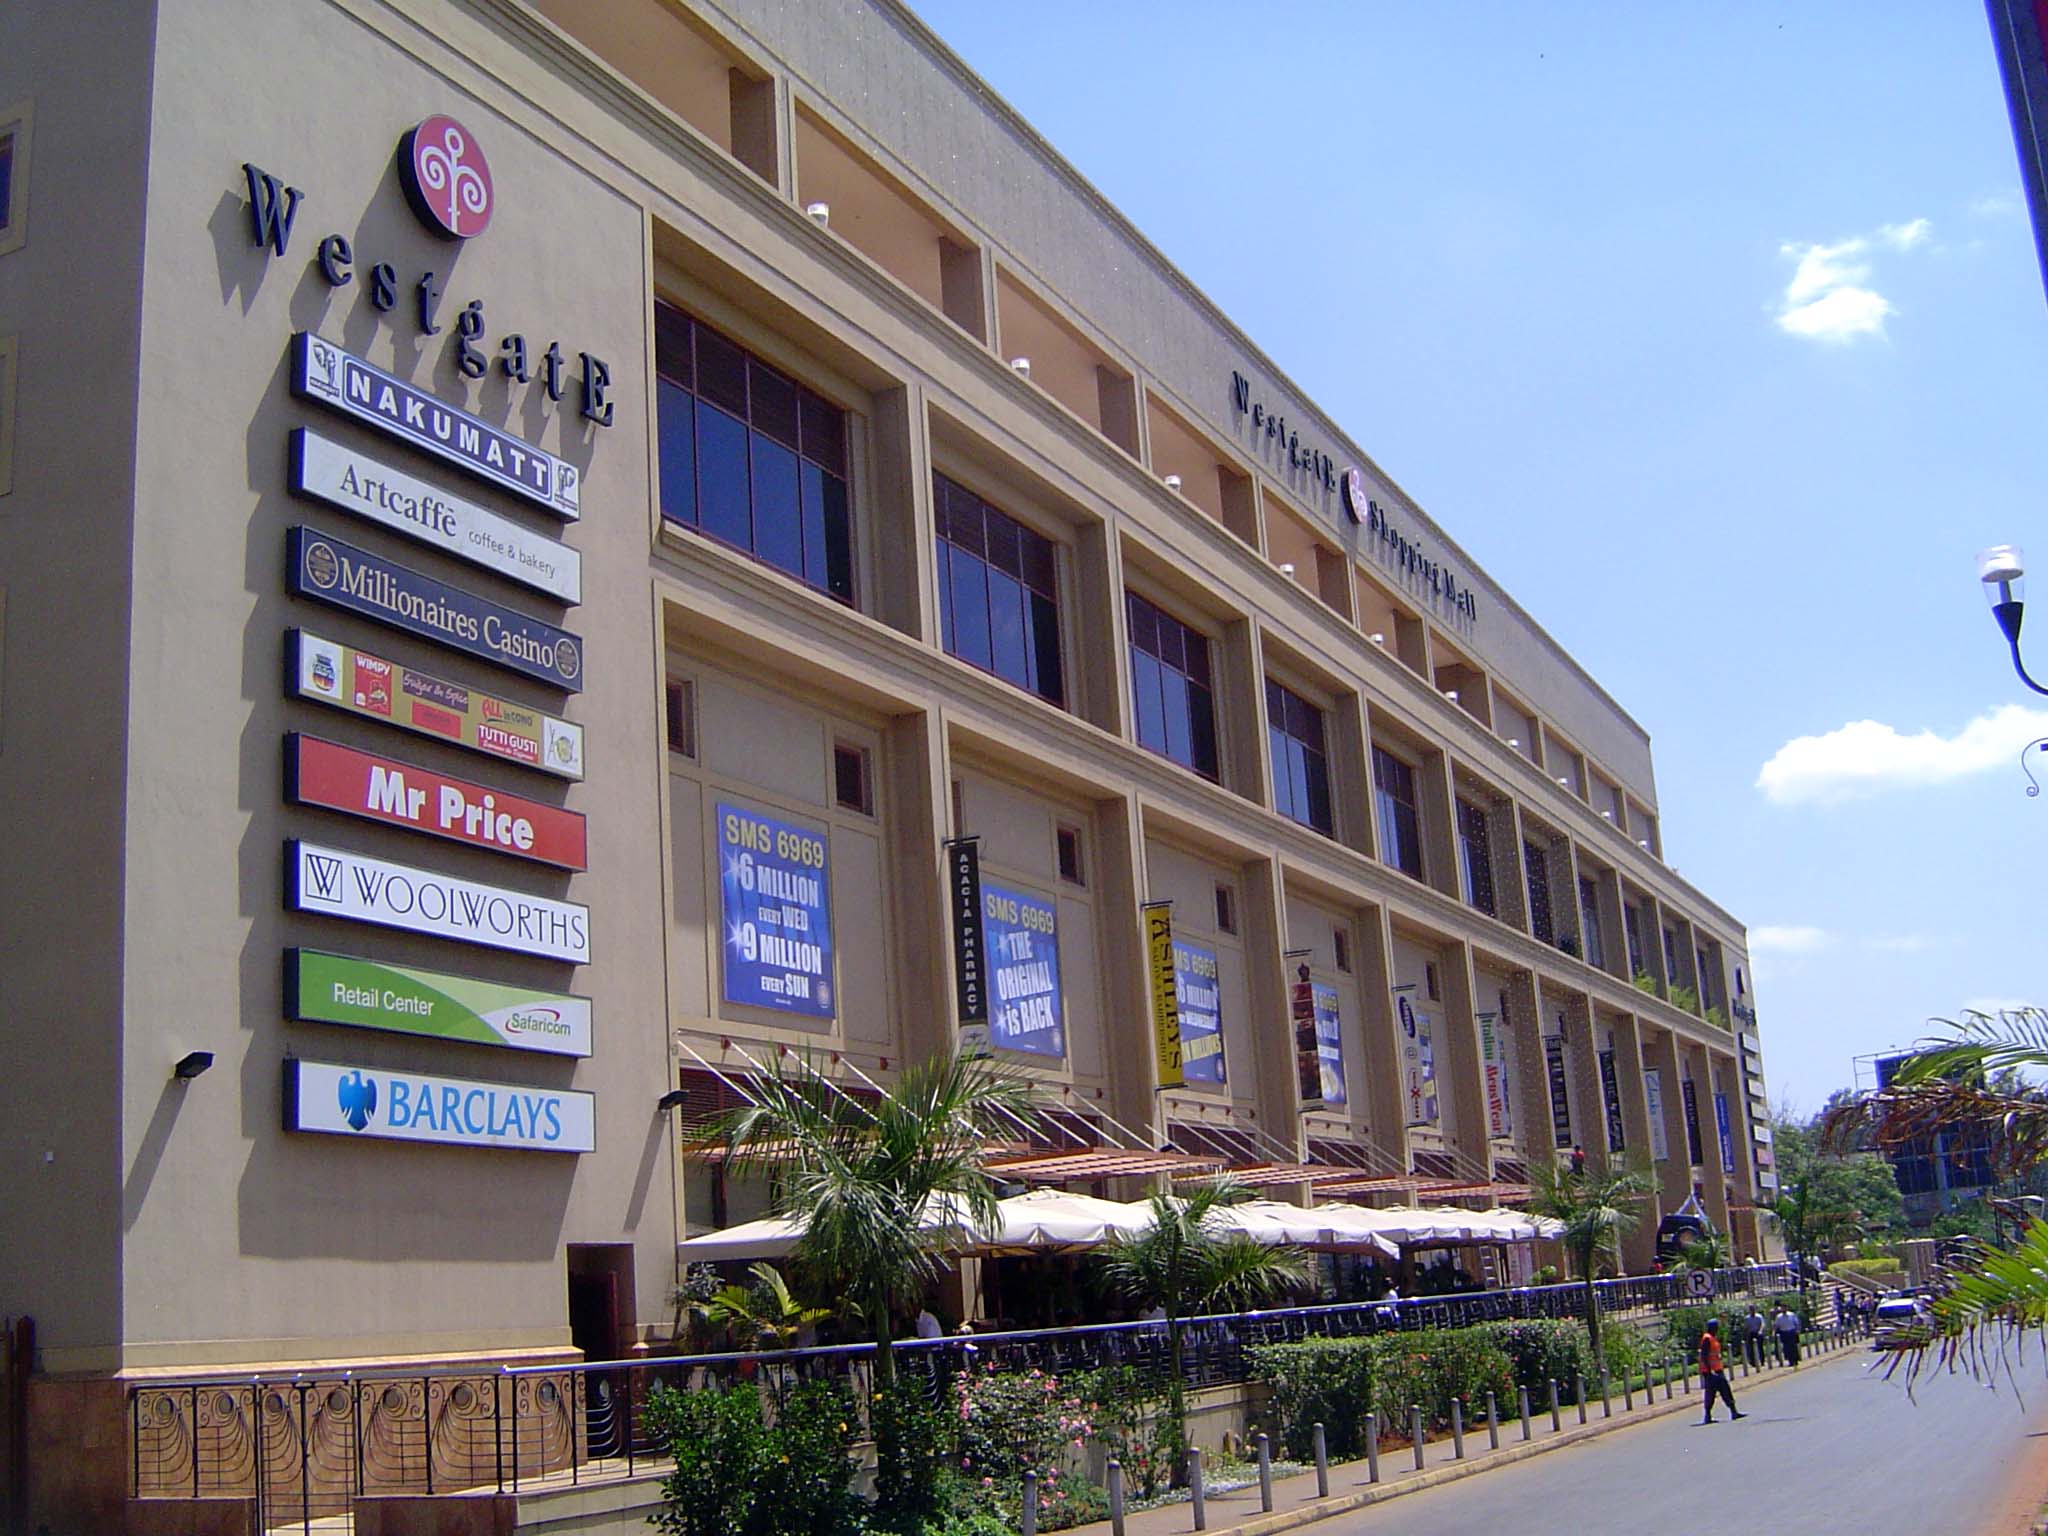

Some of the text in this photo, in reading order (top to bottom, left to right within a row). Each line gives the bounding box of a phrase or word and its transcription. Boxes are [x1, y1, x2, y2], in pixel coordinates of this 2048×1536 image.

[352, 369, 549, 488] NAKUMATT
[468, 531, 504, 554] coffee
[508, 544, 515, 559] &
[519, 548, 556, 579] bakery
[340, 557, 554, 669] Millionaires Casino
[356, 655, 391, 676] WIMPY
[480, 725, 508, 745] TUTTI
[509, 735, 538, 755] GUSTI
[367, 766, 534, 850] Mr Price
[726, 814, 824, 869] SMS 6969
[740, 852, 818, 909] 6 MILLION
[960, 853, 973, 919] ACACIA
[353, 866, 586, 950] WOOLWORTHS
[758, 905, 808, 932] EVERY WED
[986, 893, 1054, 935] SMS 6969
[742, 921, 822, 975] 9 MILLION
[1008, 931, 1032, 961] THE
[1173, 949, 1190, 972] MS
[761, 973, 809, 999] EVERY SUN
[964, 927, 977, 1015] PHARMACY
[997, 961, 1054, 1001] ORIGINAL
[1152, 917, 1182, 1070] ASHLEYS
[333, 982, 434, 1017] Retail Center
[1005, 996, 1055, 1037] is BACK
[511, 1012, 571, 1037] Safaricom
[388, 1080, 561, 1142] BARCLAYS
